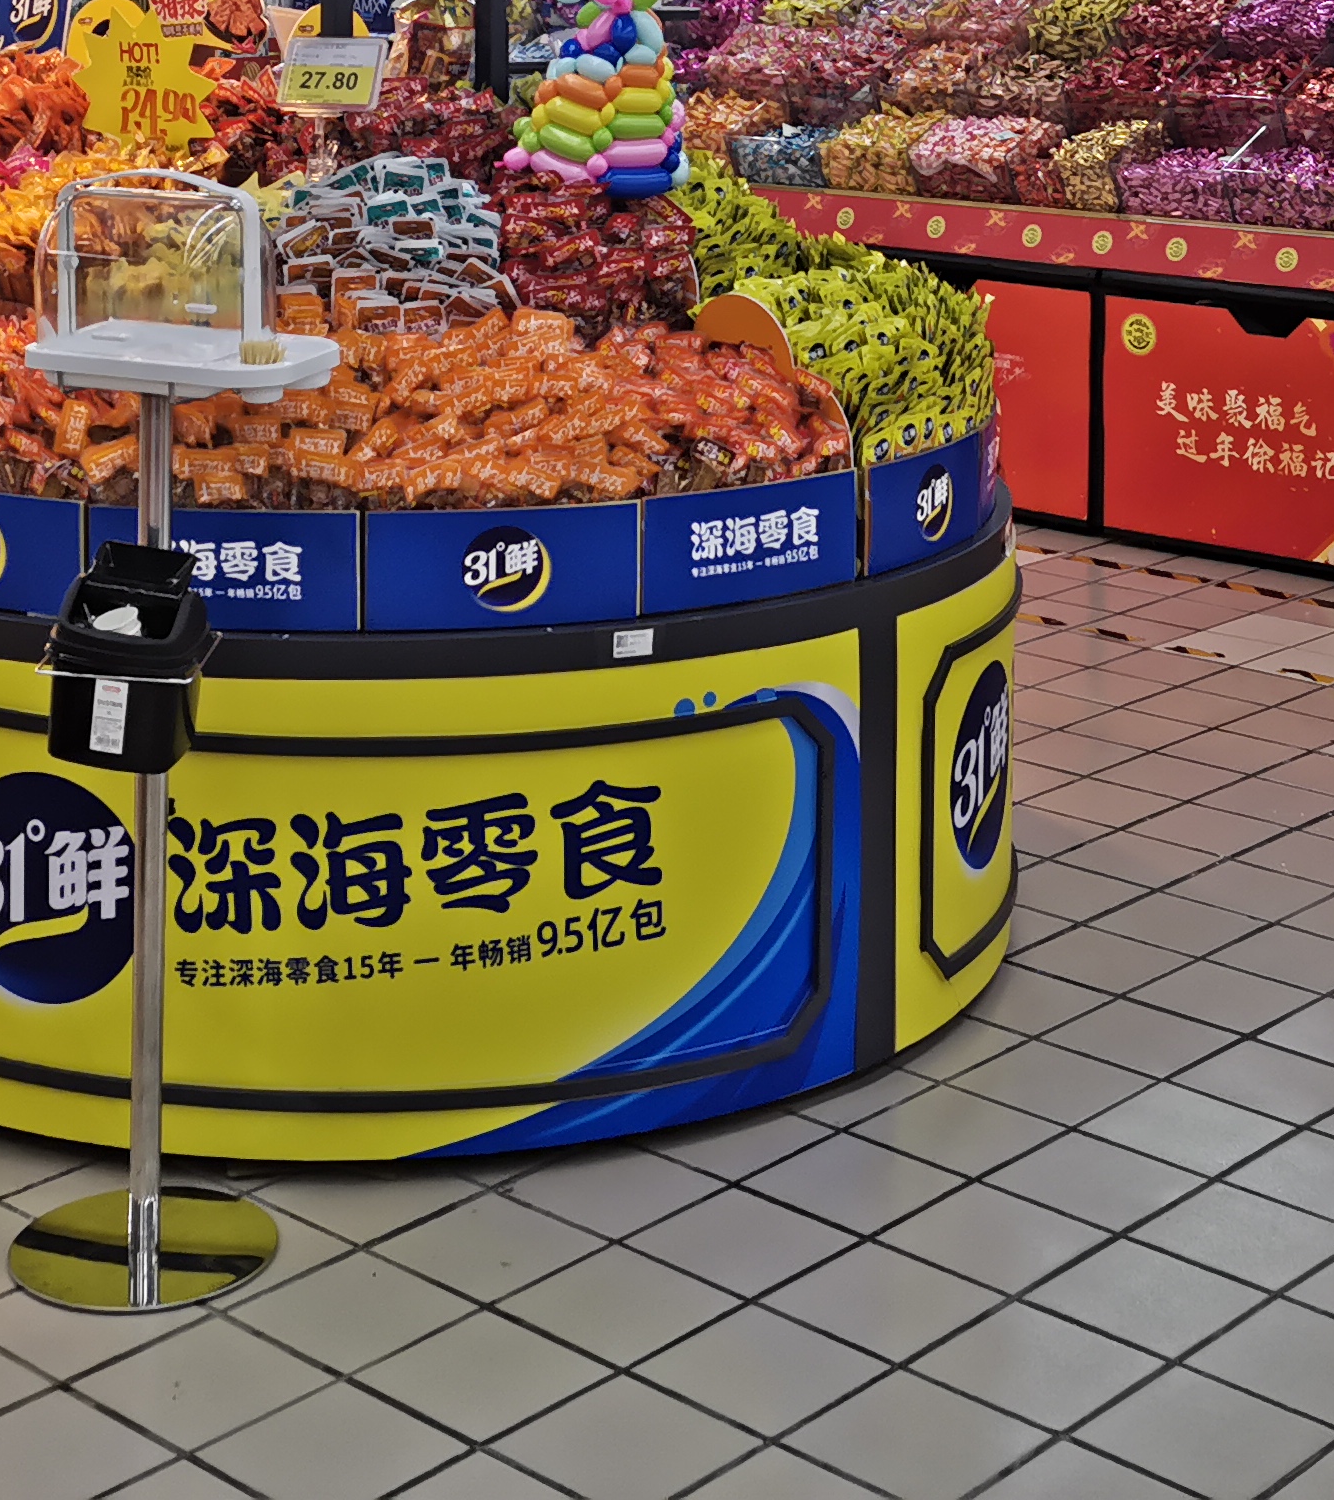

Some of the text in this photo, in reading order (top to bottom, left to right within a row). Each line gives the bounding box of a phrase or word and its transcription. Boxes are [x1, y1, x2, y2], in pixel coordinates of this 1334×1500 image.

[118, 41, 161, 64] HOT!
[298, 70, 359, 91] 27.80
[1154, 381, 1318, 437] 美味聚福气
[689, 504, 820, 563] 深海零食
[170, 538, 303, 582] 海零食
[168, 779, 663, 936] 深海零食
[174, 948, 405, 990] 专注深海零食15年
